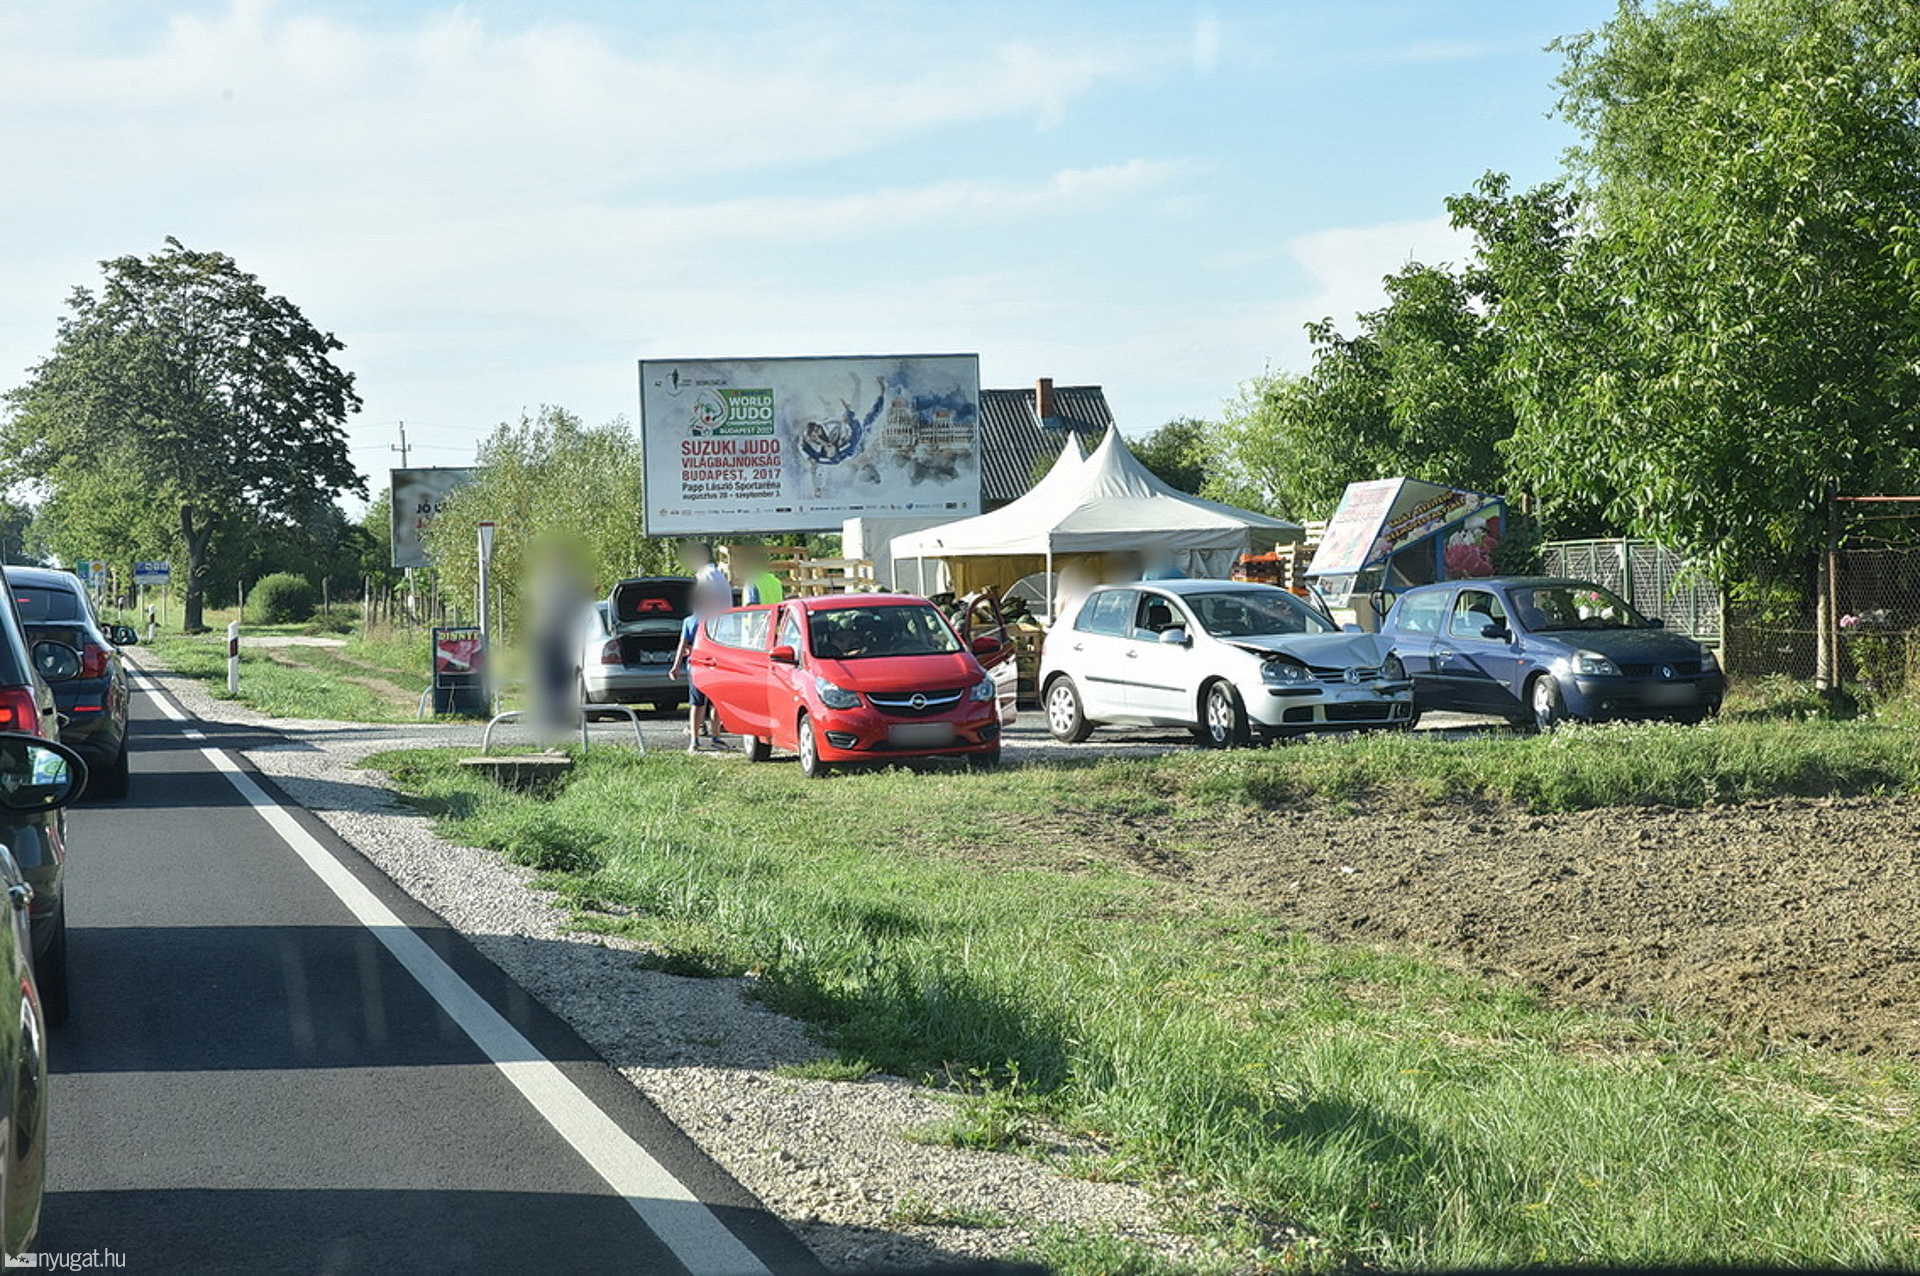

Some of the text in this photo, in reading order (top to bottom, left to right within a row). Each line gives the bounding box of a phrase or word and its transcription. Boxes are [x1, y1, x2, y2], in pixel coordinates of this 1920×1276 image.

[729, 396, 772, 407] WORLD
[729, 407, 772, 420] JUDO
[682, 439, 780, 455] SUZUKI JUDO
[682, 453, 781, 468] VILÁGBAJNOKSÁG
[752, 468, 781, 480] 2017
[682, 481, 704, 493] Papp
[705, 481, 734, 492] László
